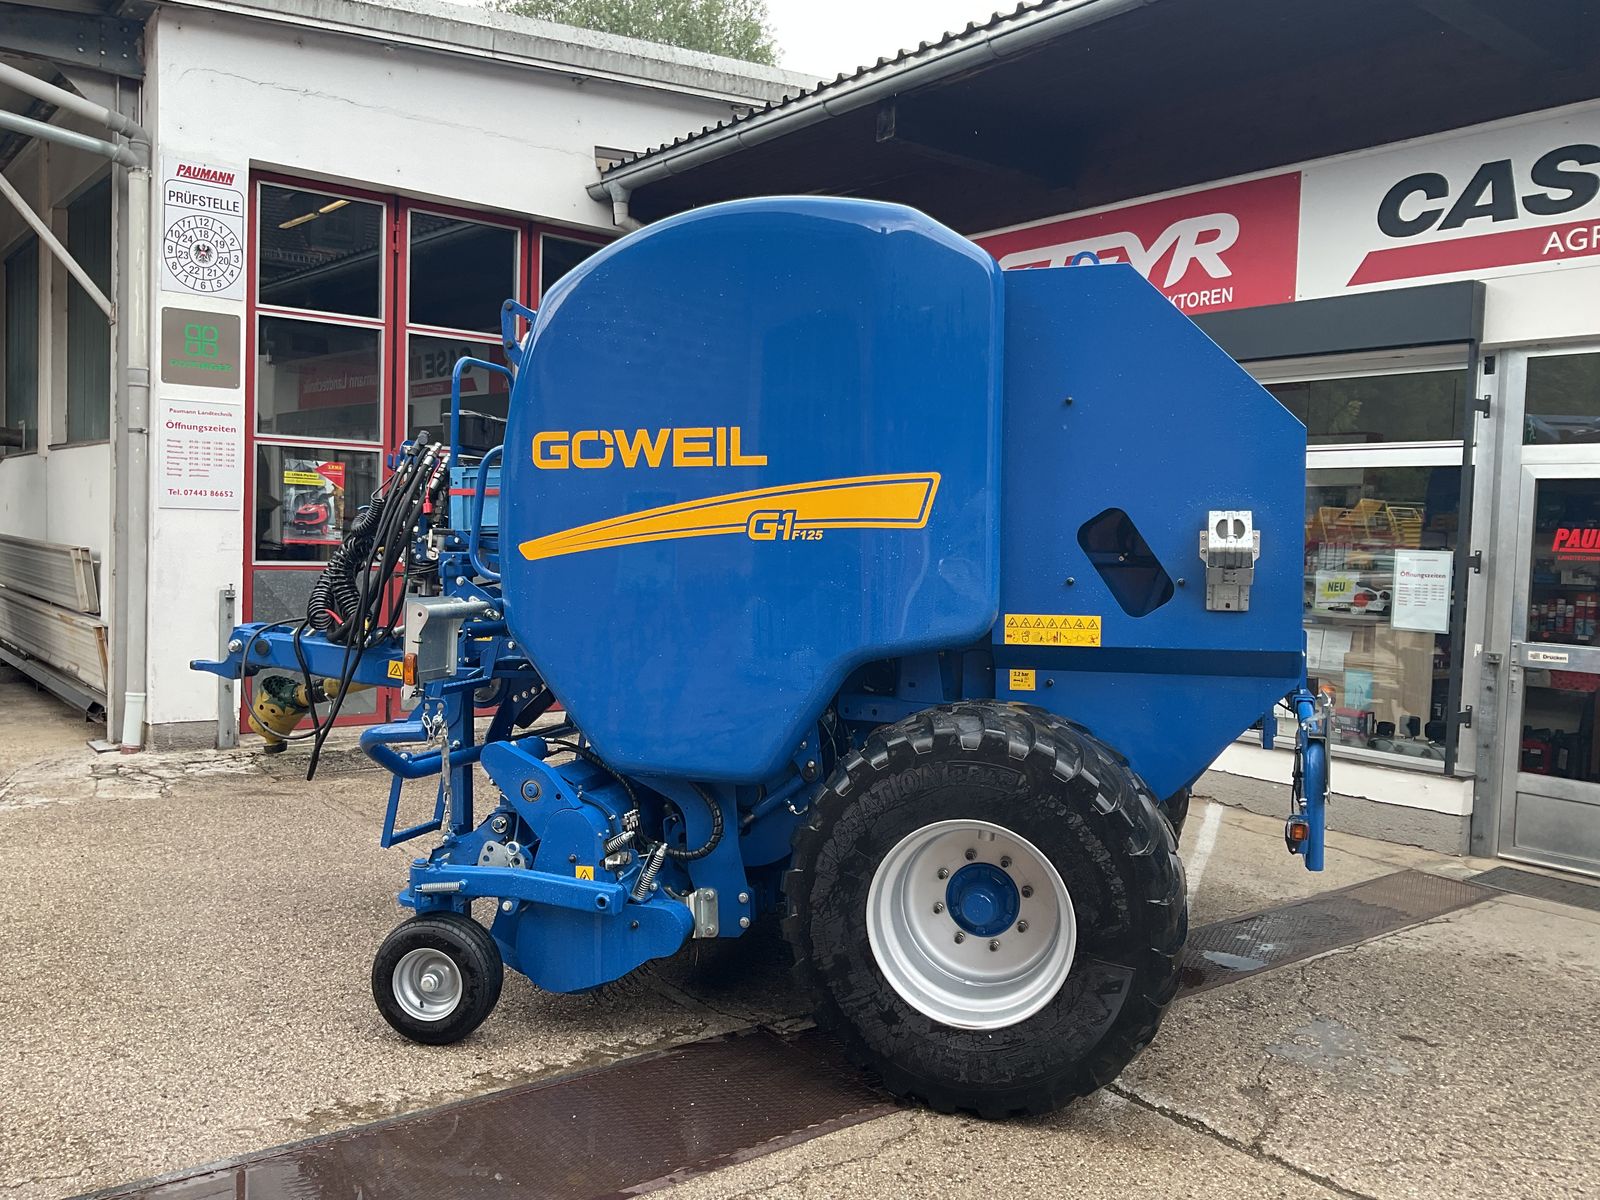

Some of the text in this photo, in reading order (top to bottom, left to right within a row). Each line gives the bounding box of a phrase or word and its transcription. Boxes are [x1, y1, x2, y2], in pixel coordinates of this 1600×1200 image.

[176, 164, 235, 186] PAUMANN
[168, 190, 240, 213] PRÜFSTELLE
[182, 220, 191, 228] 11
[199, 218, 209, 227] 12
[169, 230, 180, 239] 10
[182, 234, 193, 243] 24
[199, 230, 209, 239] 18
[215, 239, 225, 249] 19
[229, 238, 235, 247] 2
[167, 245, 173, 254] 9
[178, 250, 189, 260] 23
[234, 254, 239, 263] 3
[218, 256, 228, 265] 20
[171, 261, 177, 271] 8
[189, 266, 200, 275] 22
[207, 268, 217, 277] 21
[228, 268, 234, 278] 4
[184, 275, 189, 283] 7
[216, 279, 222, 288] 5
[200, 281, 206, 290] 6
[166, 420, 237, 433] Öffnungszeiten
[168, 488, 234, 498] Tel. 07443 86652
[792, 530, 824, 541] F125
[1400, 570, 1446, 579] Öffnungszeiten
[1327, 582, 1346, 592] NEU
